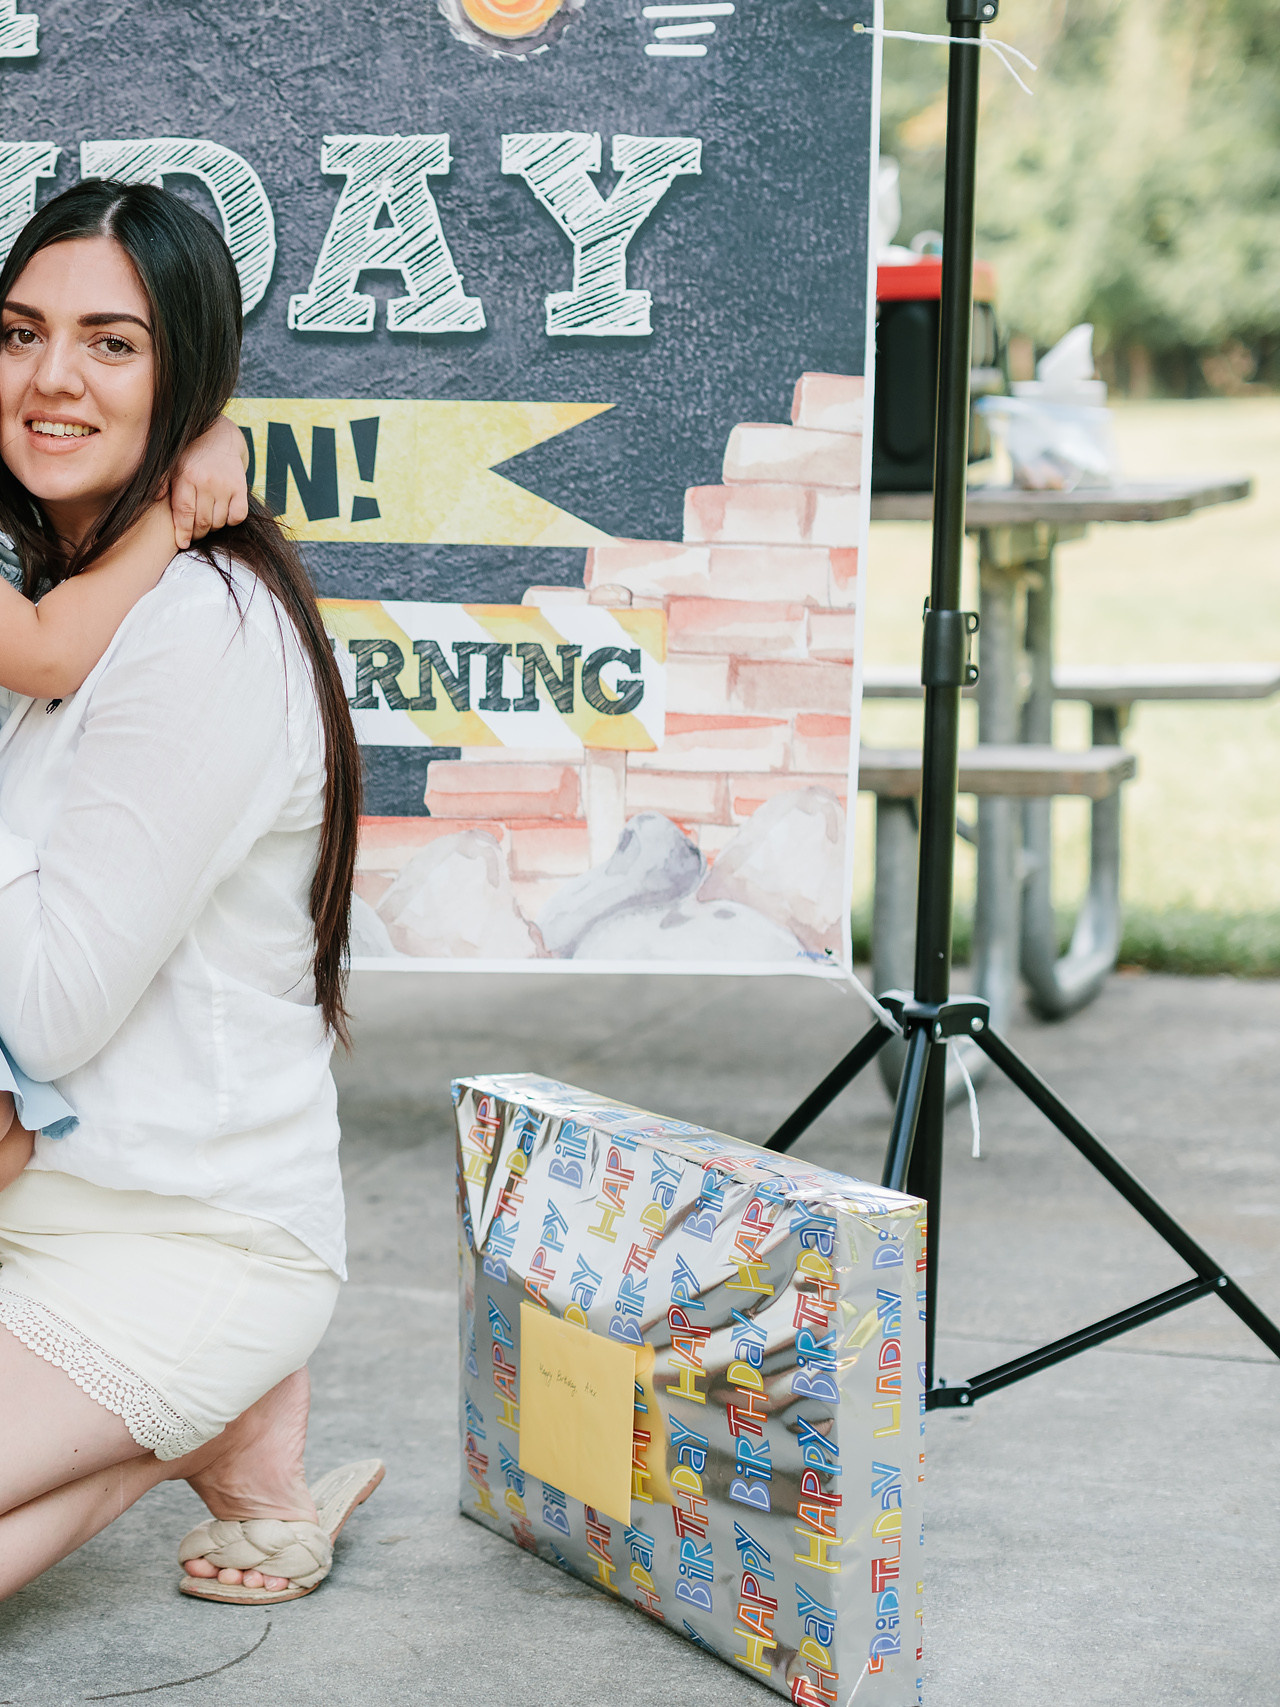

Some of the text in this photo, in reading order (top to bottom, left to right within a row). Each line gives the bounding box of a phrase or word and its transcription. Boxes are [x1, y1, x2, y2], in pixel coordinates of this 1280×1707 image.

[333, 638, 645, 715] RNING
[666, 1253, 711, 1404] HAPPY
[794, 1415, 843, 1574] HAPPY
[733, 1520, 778, 1677] HAPPY
